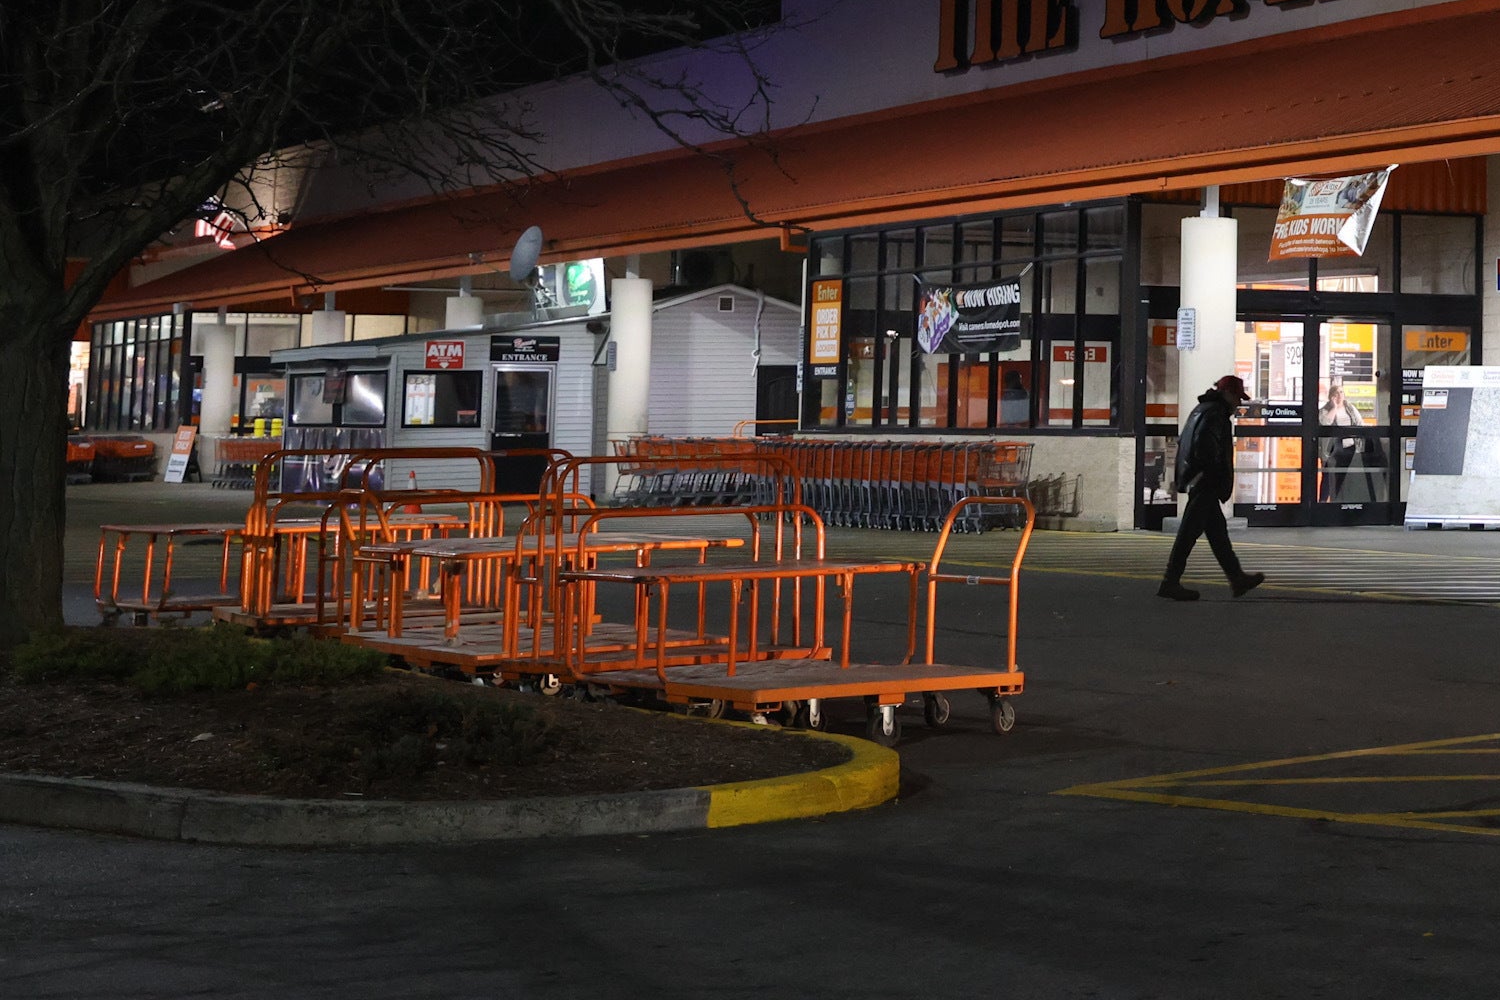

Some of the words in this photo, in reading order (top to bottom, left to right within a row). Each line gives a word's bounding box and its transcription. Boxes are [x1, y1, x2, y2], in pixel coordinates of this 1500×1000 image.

[1288, 217, 1310, 236] KIDS
[817, 284, 838, 300] Enter
[963, 288, 987, 308] NOW
[986, 283, 1020, 306] HIRING
[1420, 334, 1454, 348] nter
[427, 344, 462, 357] ATM
[502, 353, 547, 361] ENTRANCE
[814, 366, 837, 376] ENTRANCE
[1402, 369, 1417, 378] NOW
[1261, 408, 1274, 416] Buy
[1275, 407, 1298, 415] Online.
